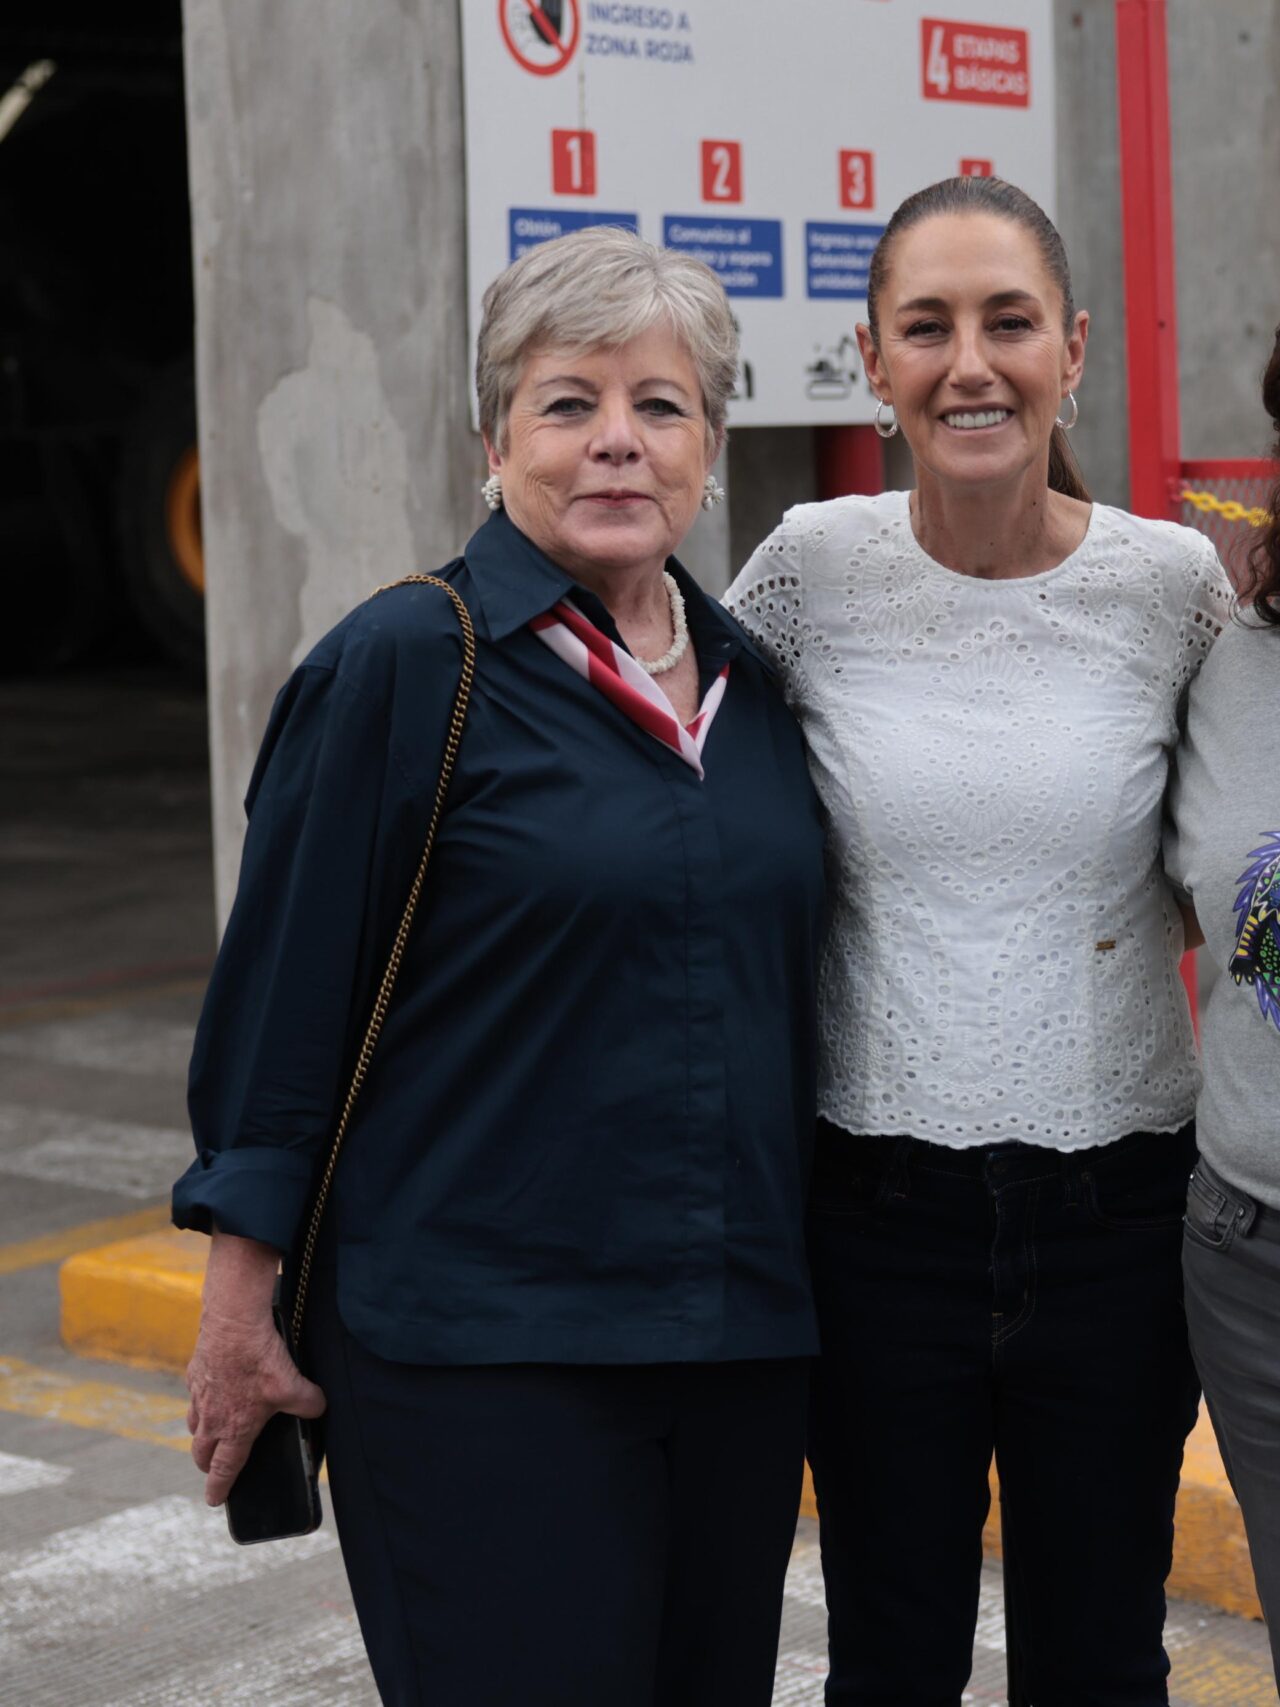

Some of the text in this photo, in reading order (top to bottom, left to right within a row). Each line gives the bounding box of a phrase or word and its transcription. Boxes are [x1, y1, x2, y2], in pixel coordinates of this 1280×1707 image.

[676, 10, 692, 32] A
[586, 34, 640, 59] ZONA
[927, 26, 949, 94] 4
[953, 33, 1020, 64] ETAPAS
[566, 135, 583, 190] 1
[711, 146, 732, 198] 2
[847, 155, 866, 204] 3
